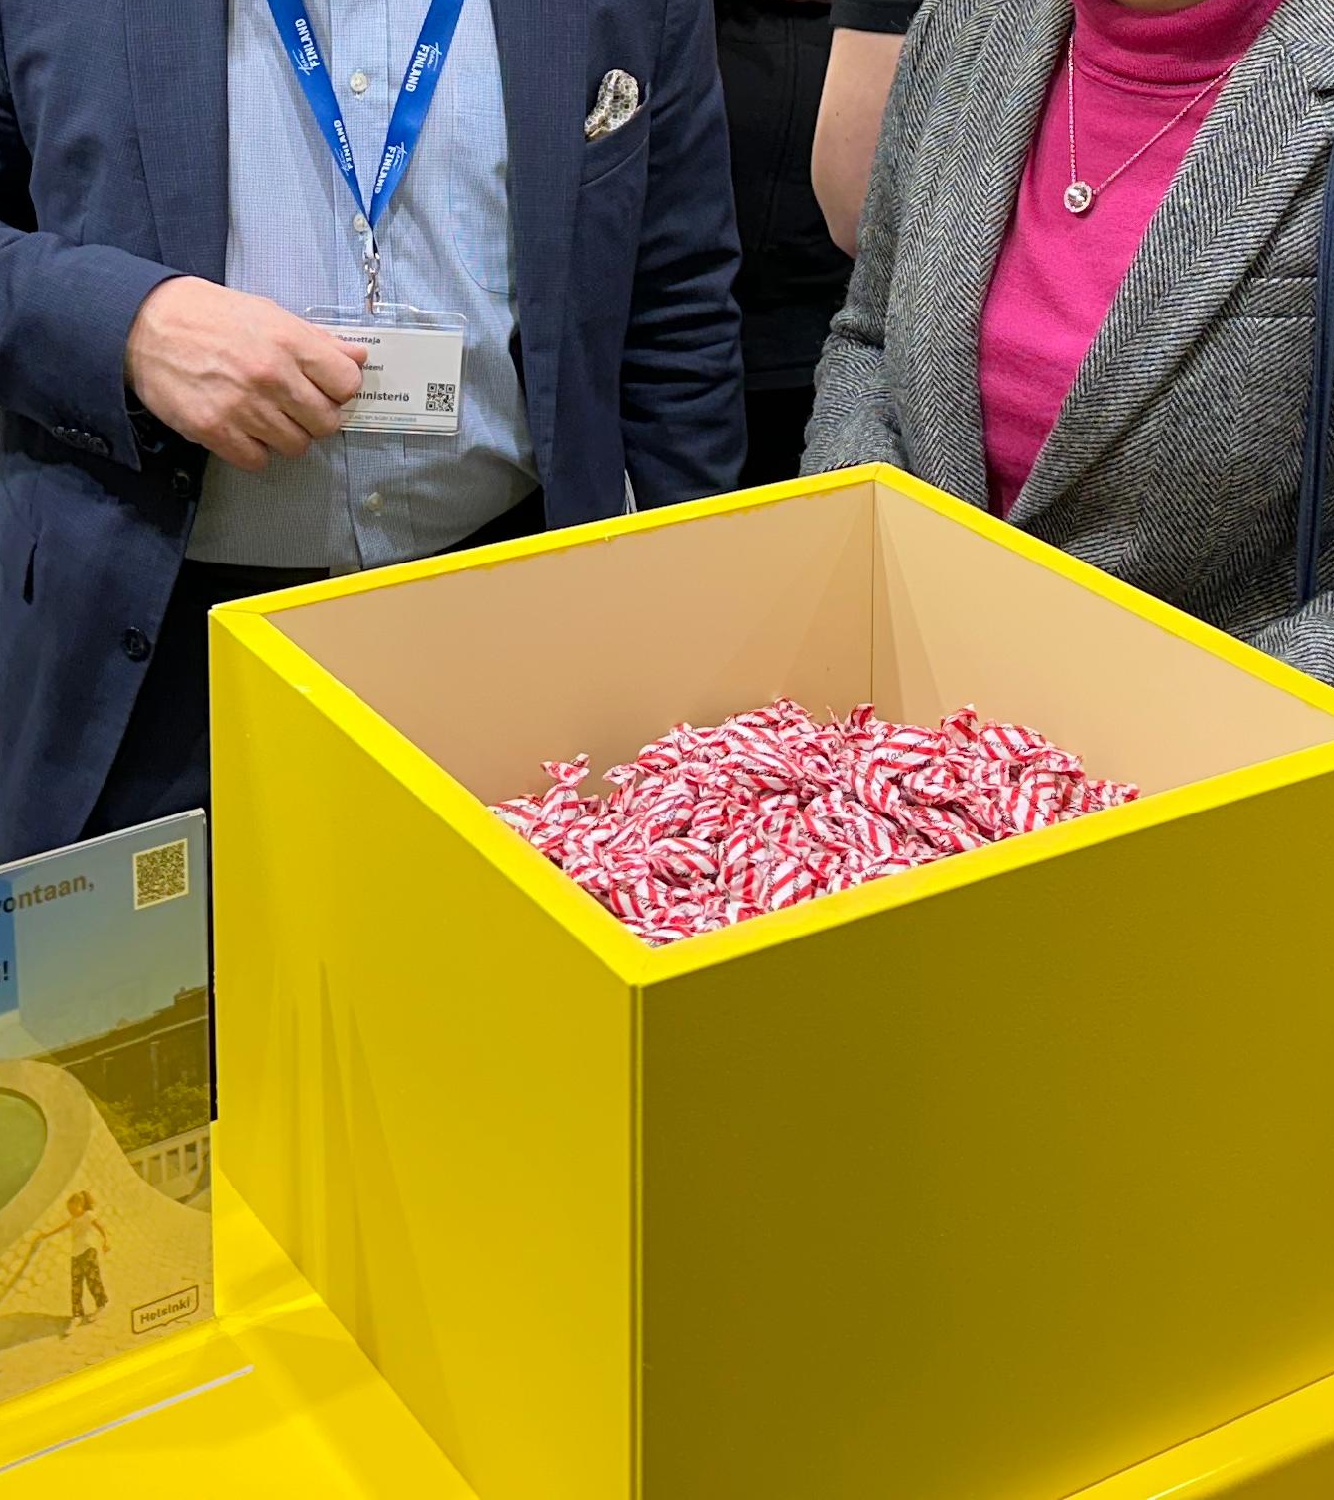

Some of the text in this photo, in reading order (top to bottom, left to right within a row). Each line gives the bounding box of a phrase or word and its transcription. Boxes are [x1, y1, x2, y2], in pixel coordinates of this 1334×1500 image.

[294, 18, 320, 68] FINLAND
[405, 43, 431, 93] FINLAND
[333, 119, 354, 171] FINLAND
[374, 145, 397, 195] FINLAND
